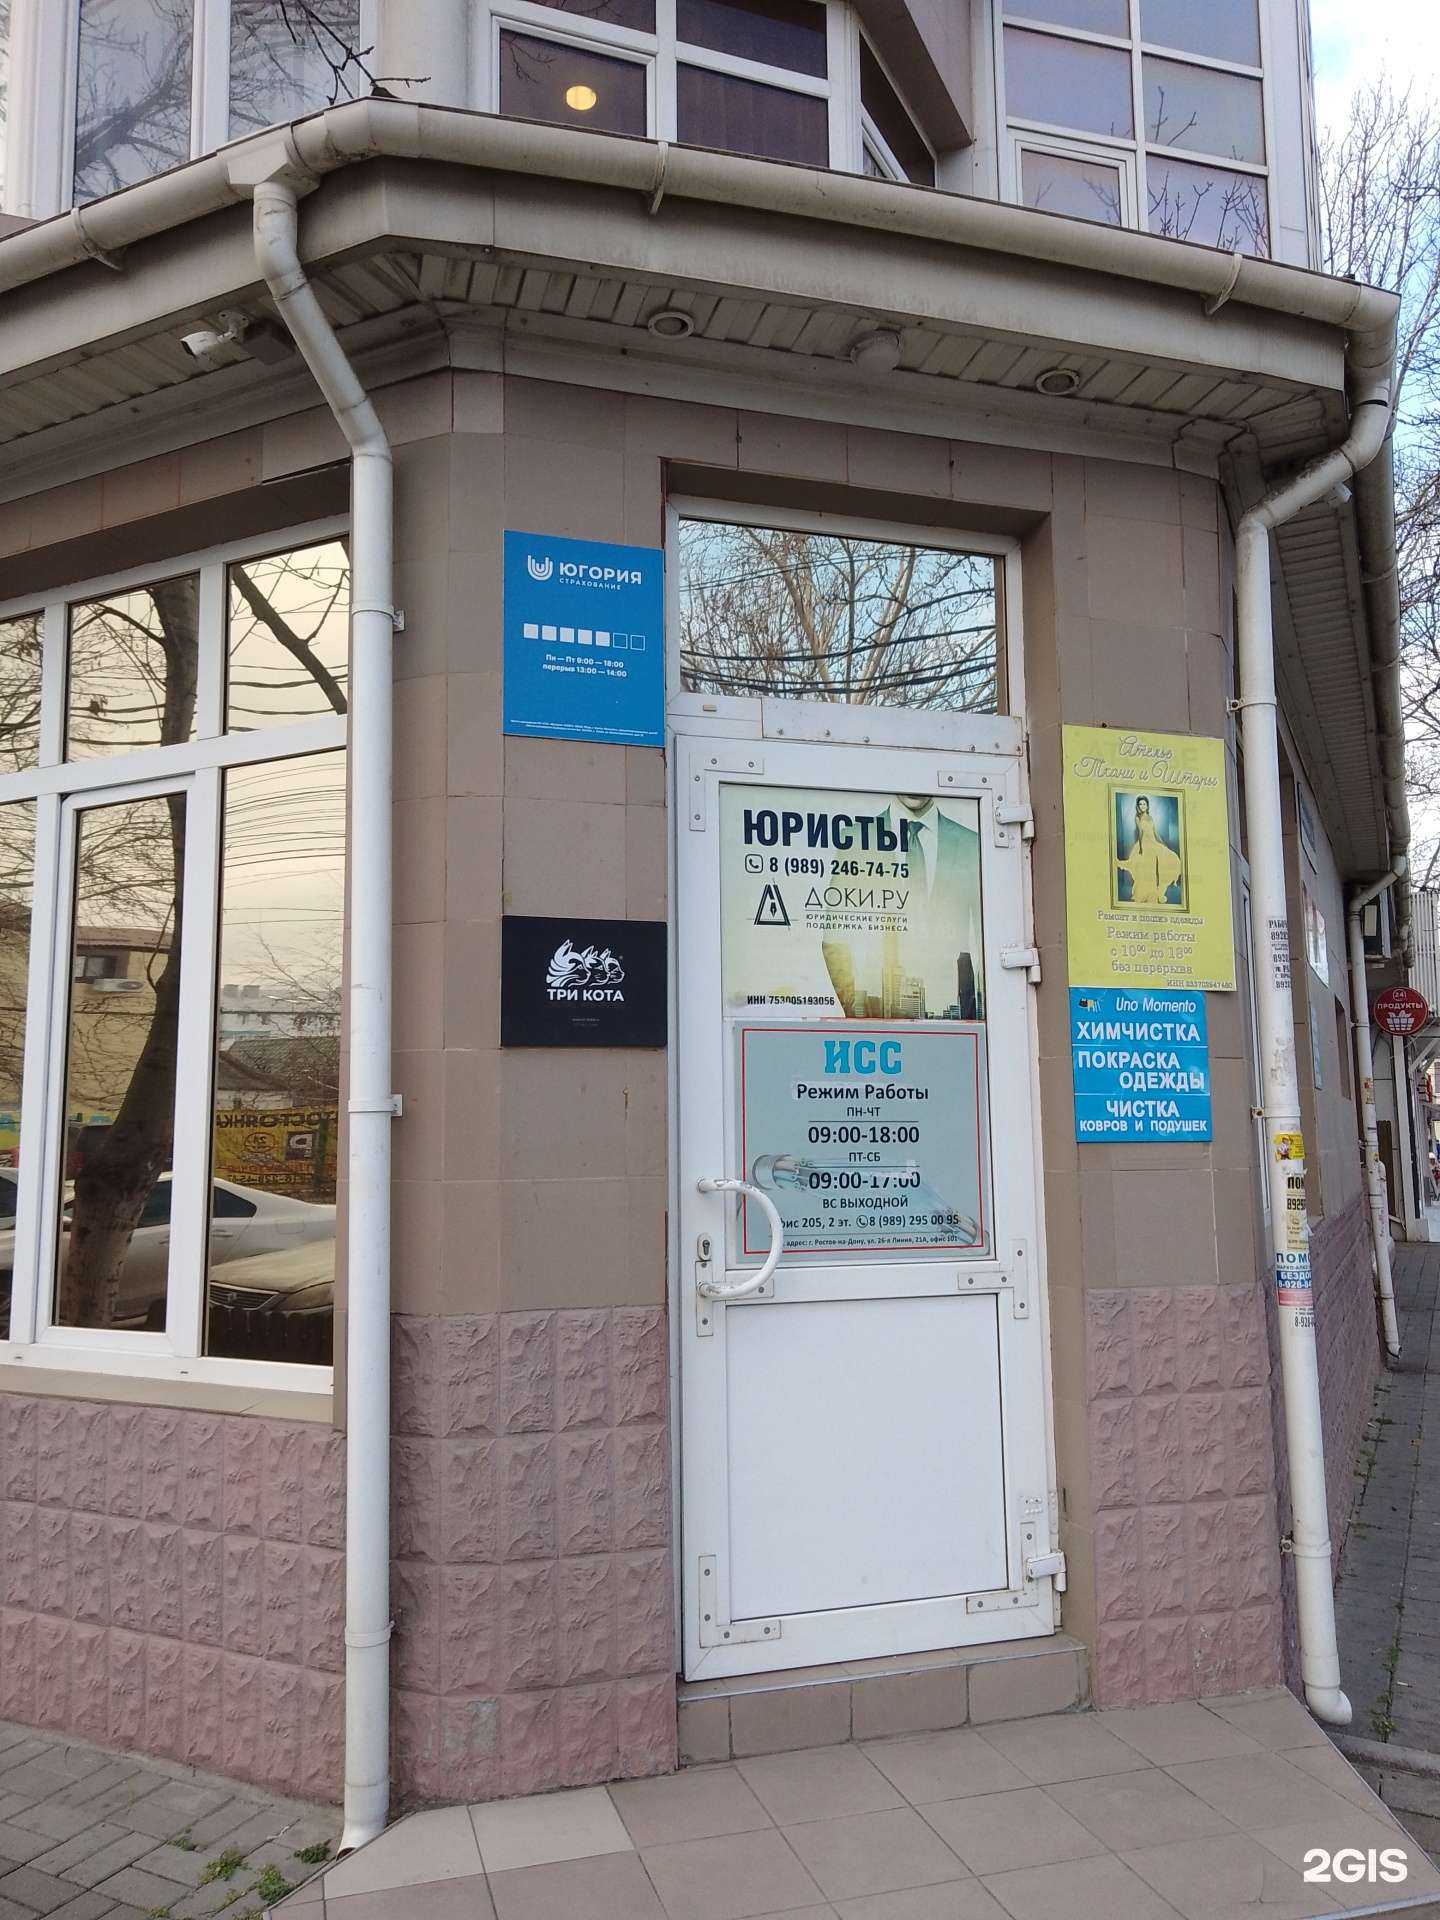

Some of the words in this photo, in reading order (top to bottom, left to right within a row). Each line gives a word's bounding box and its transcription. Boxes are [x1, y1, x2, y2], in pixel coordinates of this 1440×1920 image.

[559, 562, 642, 585] ЮГОРИЯ
[559, 578, 622, 591] СТРАХОВАНИЕ
[576, 666, 597, 675] 13:00
[606, 669, 627, 677] 14:00
[1139, 770, 1149, 781] и
[743, 809, 909, 853] ЮРИСТЫ
[769, 859, 779, 873] 8
[784, 857, 825, 878] (989)
[830, 859, 909, 879] 246-74-75
[804, 886, 910, 910] ДОКИ.РУ
[806, 913, 873, 923] ЮРИДИЧЕСКИЕ
[875, 915, 908, 924] УСЛУГИ
[806, 922, 863, 931] ПОДДЕРЖКА
[868, 924, 908, 932] БИЗНЕСА
[1106, 927, 1150, 940] Режим
[1153, 930, 1196, 943] работы
[1149, 950, 1164, 960] до
[1111, 959, 1131, 972] без
[1134, 964, 1193, 976] перерыва
[547, 989, 578, 1001] ТРИ
[583, 989, 625, 1002] КОТА
[747, 995, 766, 1005] ИНН
[1115, 998, 1138, 1012] Uno
[1142, 998, 1197, 1013] Momento
[1377, 1002, 1423, 1010] ПРОДУКТЫ
[1076, 1021, 1201, 1042] ХИМЧИСТКА
[824, 1040, 902, 1075] ИСС
[1078, 1051, 1181, 1069] ПОКРАСКА
[1119, 1071, 1205, 1092] ОДЕЖДЫ
[797, 1083, 859, 1100] Режим
[865, 1083, 929, 1100] Работы
[847, 1106, 881, 1117] ПН-ЧТ
[1106, 1099, 1181, 1118] ЧИСТКА
[1079, 1120, 1128, 1132] КОВРОВ
[1135, 1120, 1143, 1132] И
[1150, 1120, 1207, 1133] ПОДУШЕК
[807, 1126, 920, 1144] 09:00-18:00
[848, 1152, 881, 1163] ПТ-СБ
[808, 1172, 921, 1190] 09:00-17:00
[822, 1198, 839, 1209] ВС
[840, 1195, 909, 1211] ВЫХОДНОЙ
[802, 1217, 825, 1229] 205,
[828, 1217, 835, 1227] 2
[838, 1219, 852, 1227] эт.
[869, 1216, 876, 1226] 8
[879, 1215, 906, 1228] (989)
[909, 1215, 928, 1225] 295
[931, 1214, 944, 1225] 00
[946, 1214, 959, 1225] 95
[1276, 1252, 1311, 1264] ПОМ
